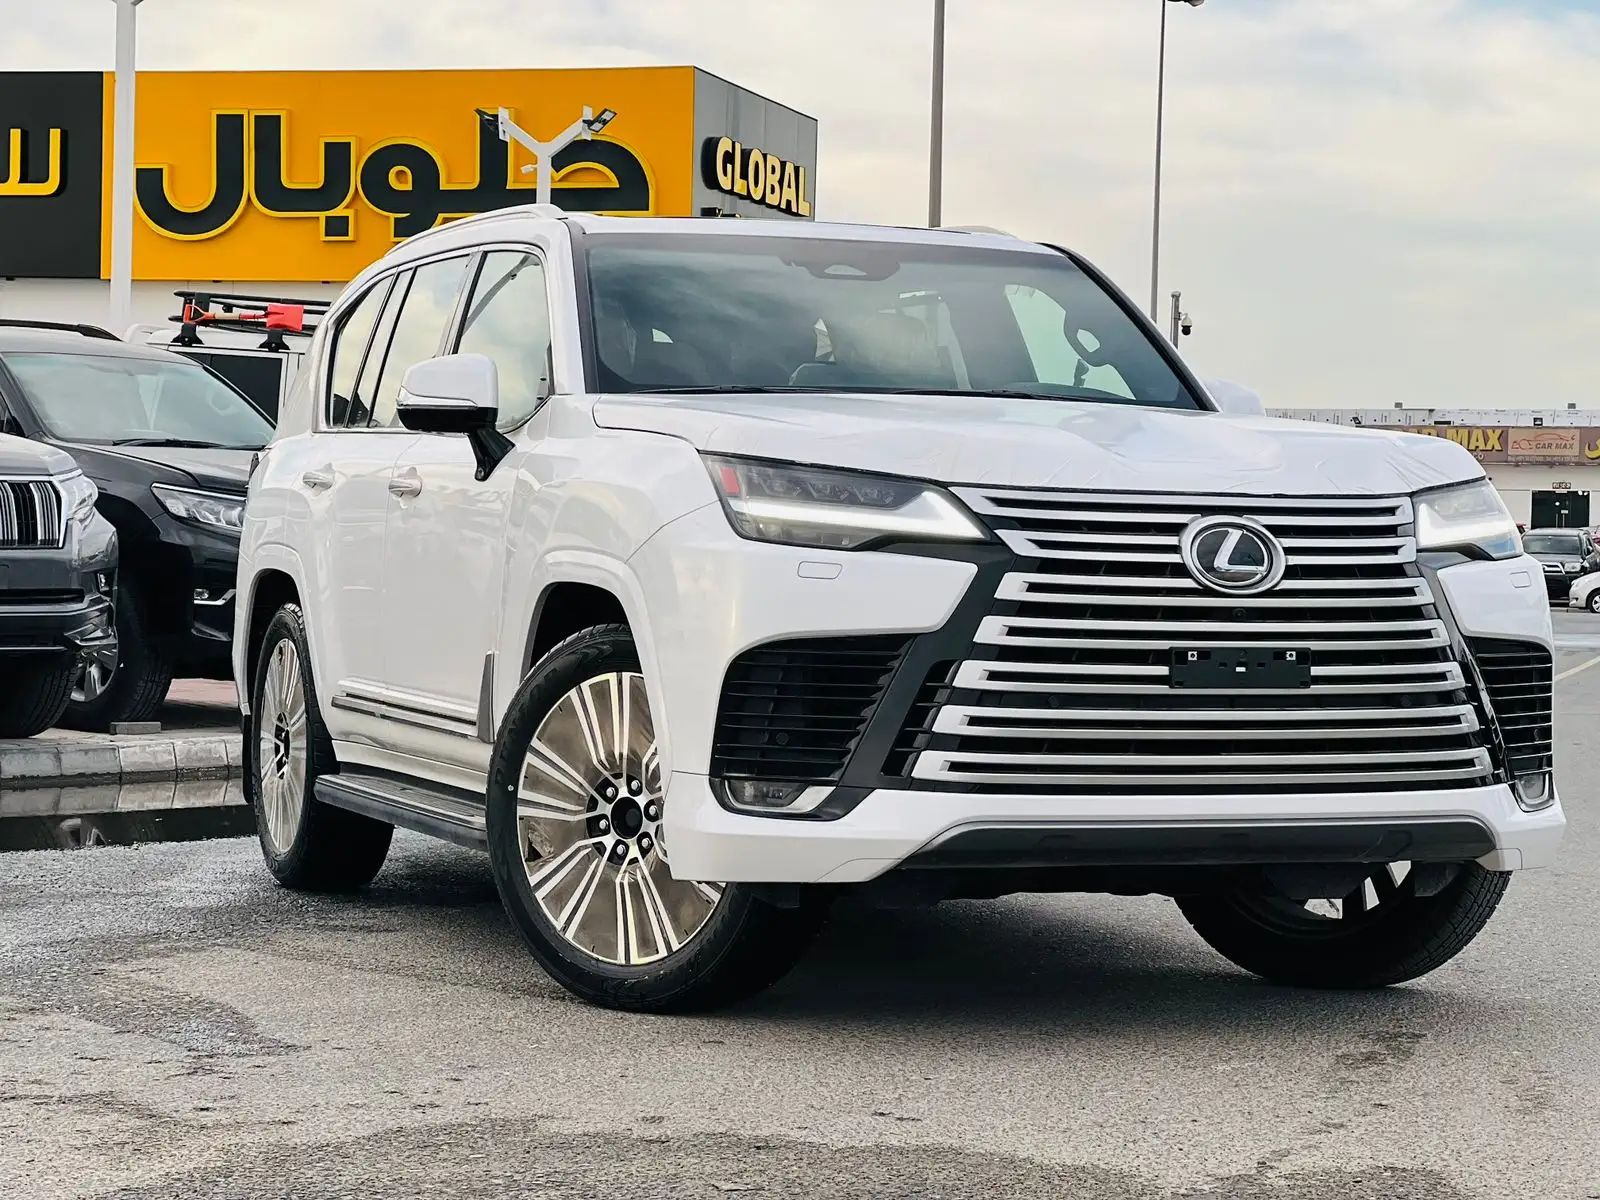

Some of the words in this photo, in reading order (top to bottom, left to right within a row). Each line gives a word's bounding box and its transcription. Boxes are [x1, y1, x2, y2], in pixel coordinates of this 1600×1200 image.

[715, 135, 811, 217] GLOBAL
[1446, 428, 1504, 451] MAX
[1535, 442, 1553, 450] CAR
[1555, 442, 1575, 450] MAX
